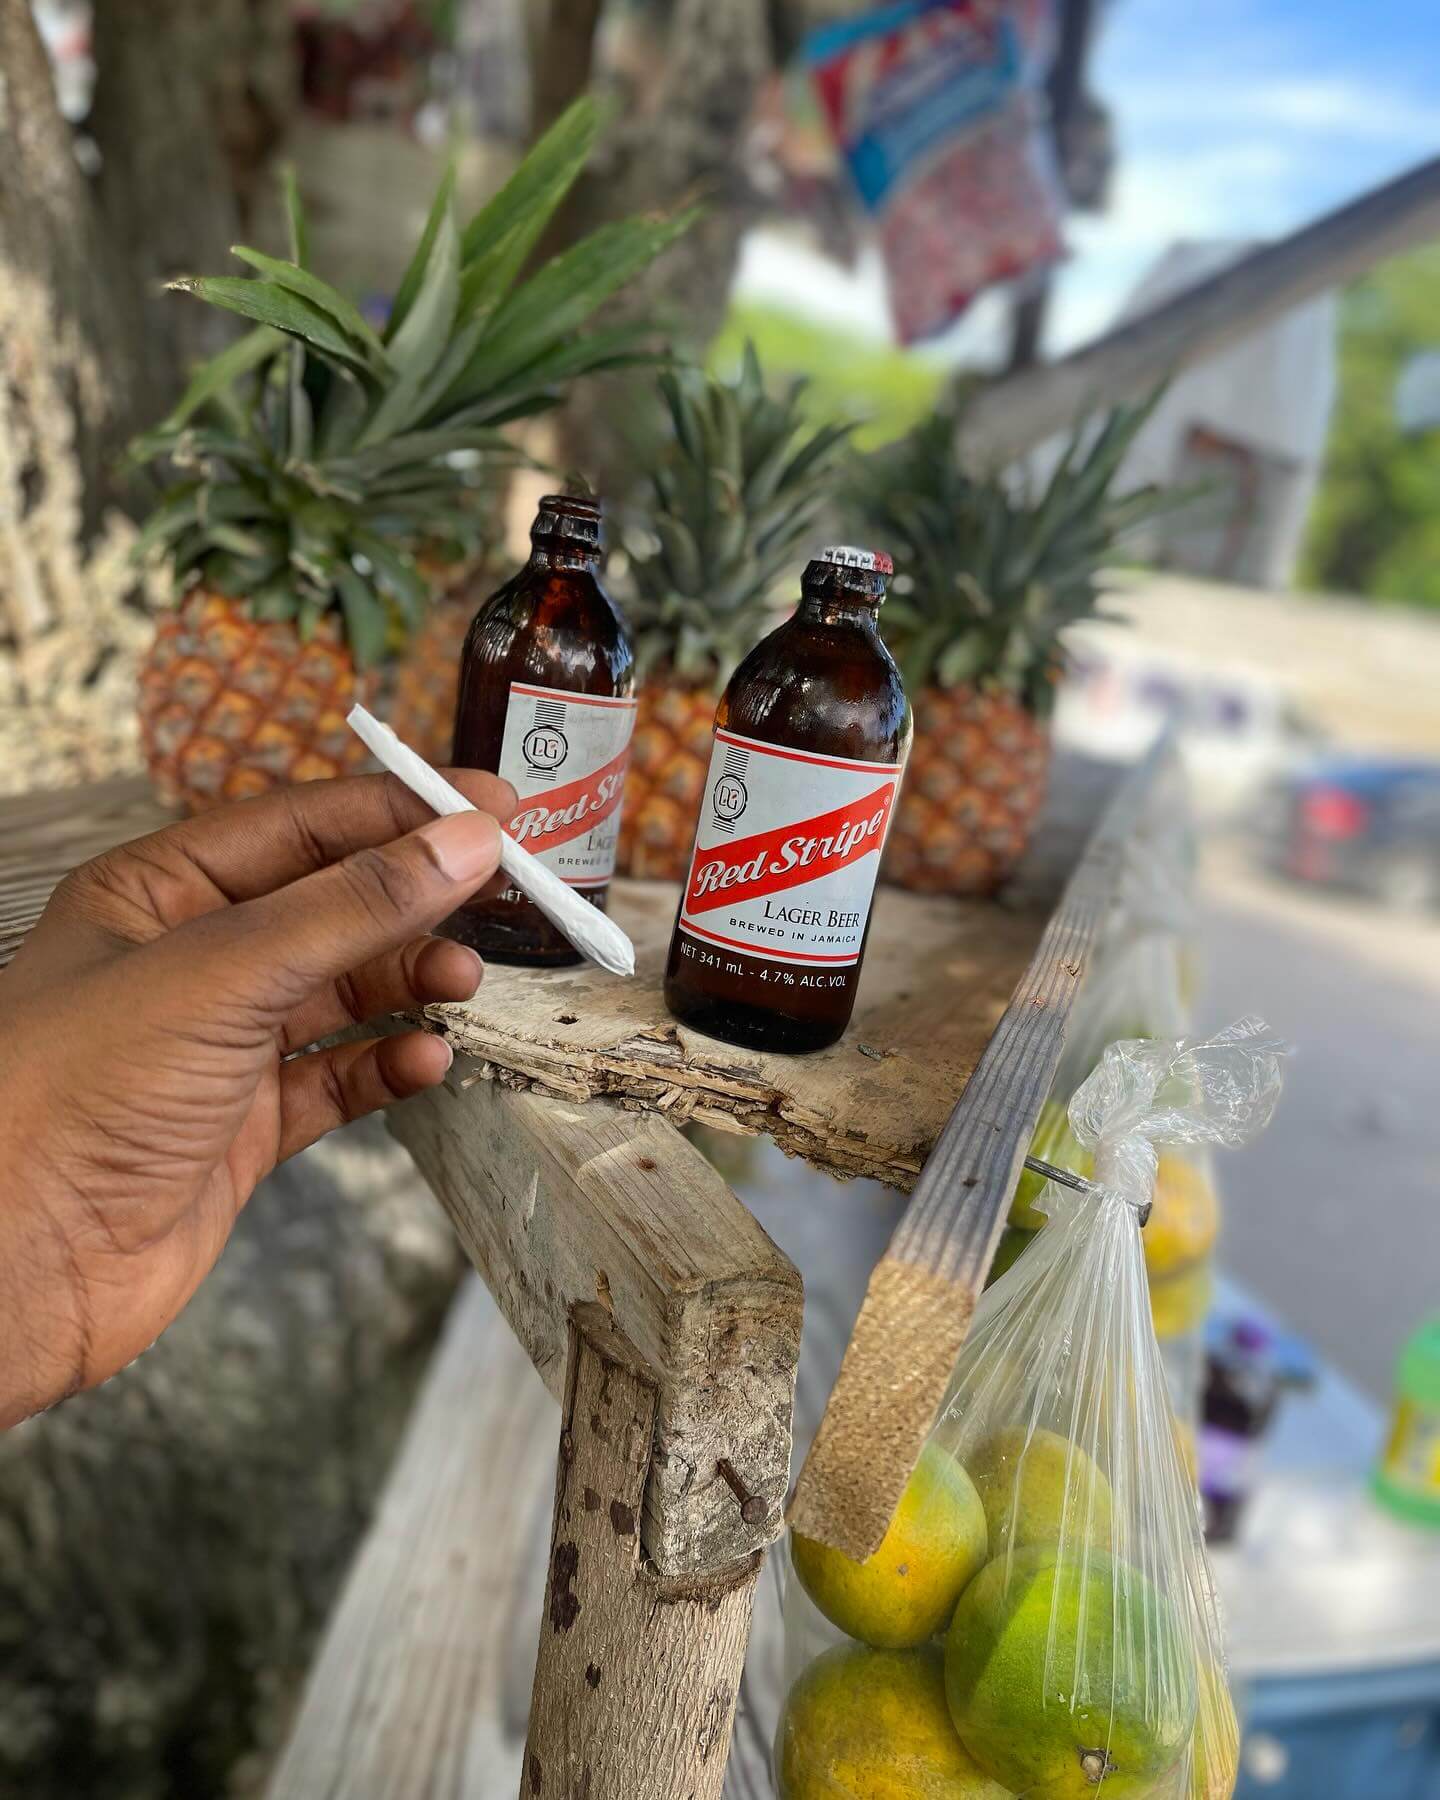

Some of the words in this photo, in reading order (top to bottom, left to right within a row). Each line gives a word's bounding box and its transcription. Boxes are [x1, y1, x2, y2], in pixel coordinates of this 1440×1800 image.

[510, 793, 589, 843] Red
[693, 850, 768, 897] Red
[769, 808, 883, 874] Stripe
[729, 917, 785, 938] BREWED
[792, 931, 805, 941] IN
[811, 934, 857, 943] JAMAICA
[763, 900, 821, 927] LAGER
[827, 910, 860, 928] BEER
[680, 942, 698, 959] NET
[699, 951, 721, 969] 341
[726, 962, 744, 976] mL
[760, 968, 795, 985] 4.7%
